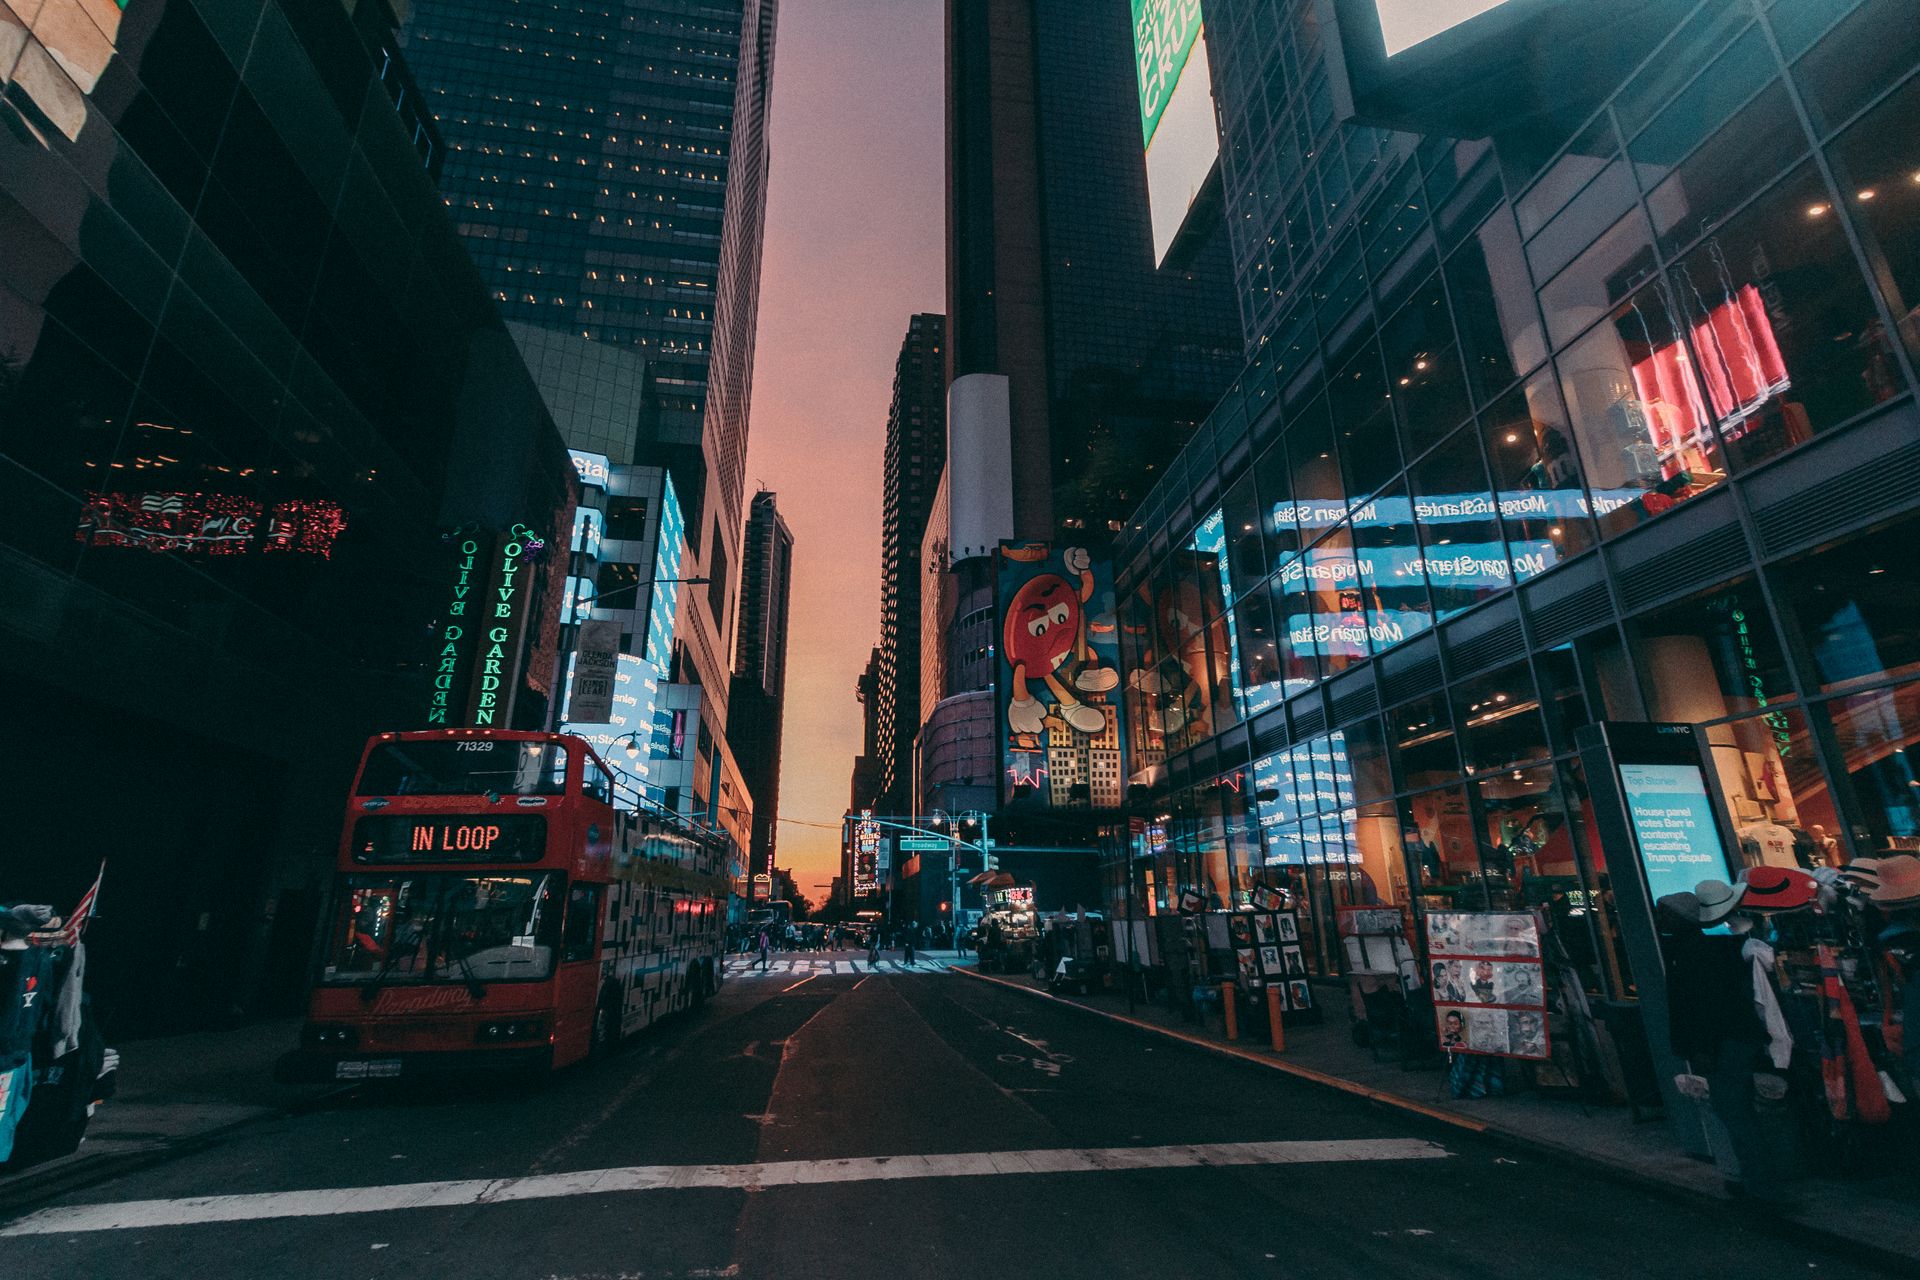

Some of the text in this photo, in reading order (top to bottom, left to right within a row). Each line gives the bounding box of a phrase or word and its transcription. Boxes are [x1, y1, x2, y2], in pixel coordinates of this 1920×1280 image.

[475, 542, 523, 725] OLIVE GARDEN
[578, 657, 616, 669] JACKSON
[456, 741, 494, 752] 71329
[1627, 776, 1677, 787] Top Stories
[1634, 807, 1692, 820] House panel
[1637, 818, 1696, 828] votes Barr in
[412, 825, 500, 851] IN LOOP
[1640, 830, 1688, 841] contempt,
[911, 842, 938, 850] Broadway
[1643, 841, 1692, 852] escalating
[1646, 853, 1712, 864] Trump dispute
